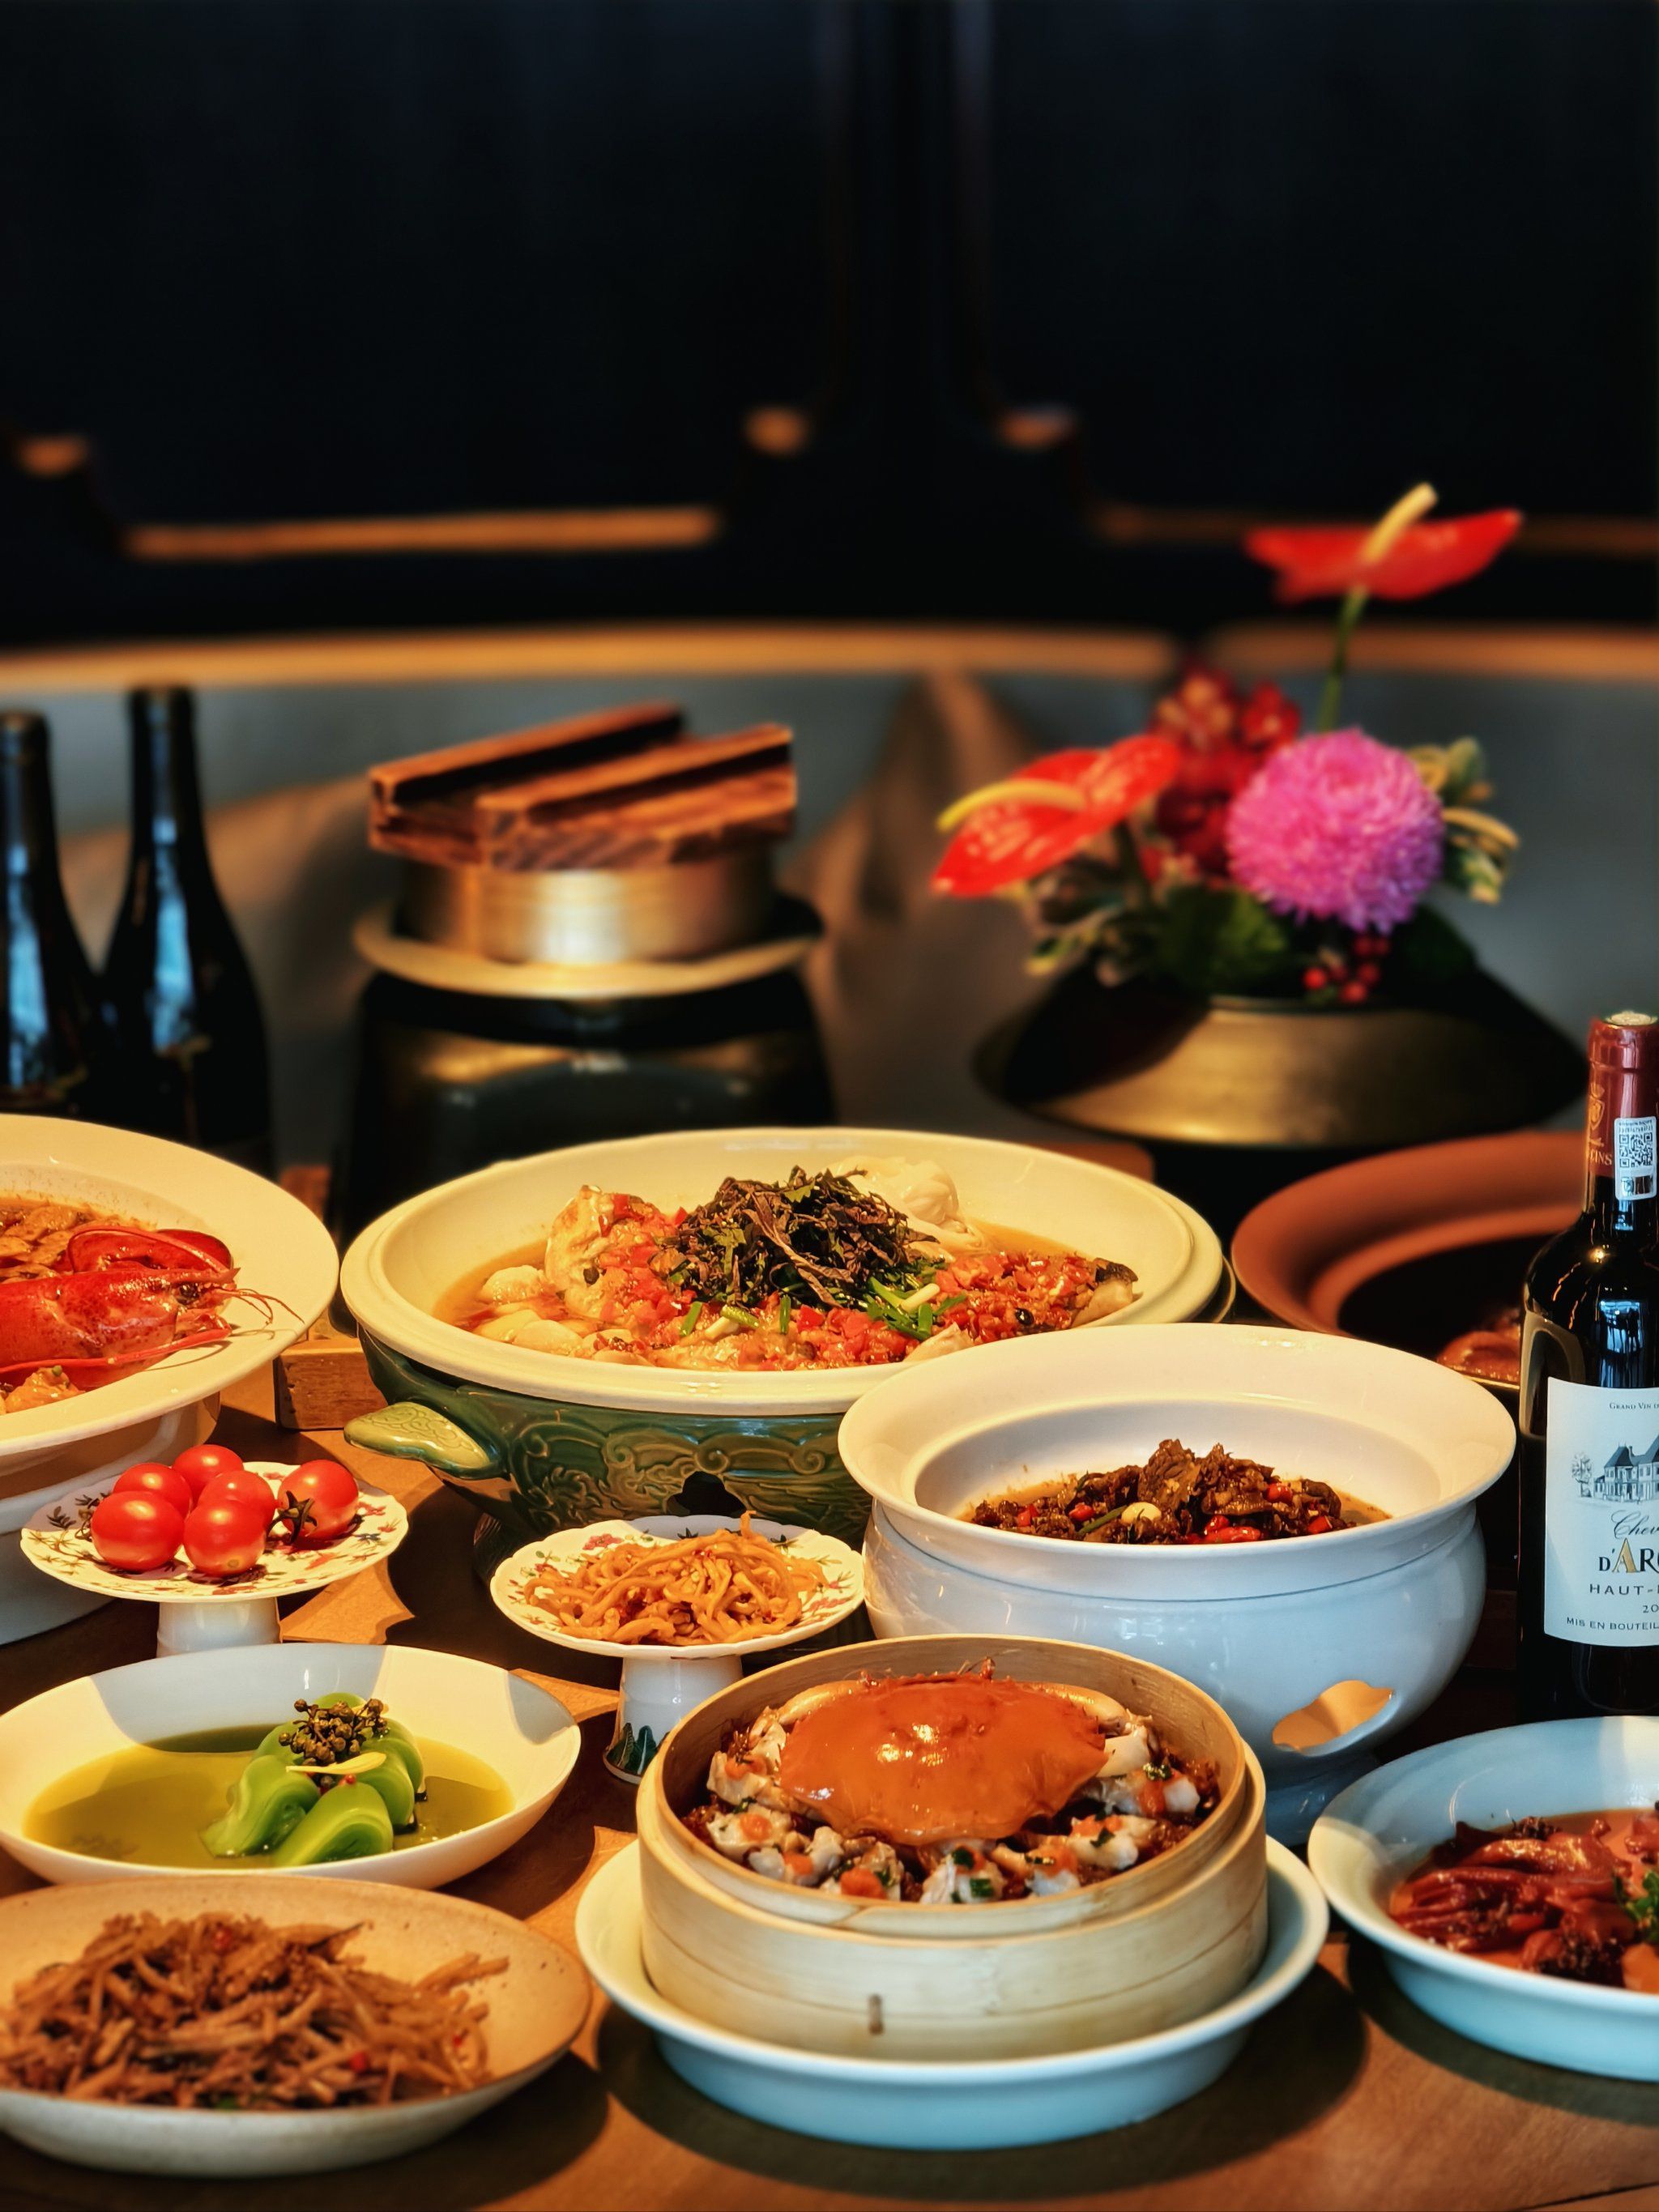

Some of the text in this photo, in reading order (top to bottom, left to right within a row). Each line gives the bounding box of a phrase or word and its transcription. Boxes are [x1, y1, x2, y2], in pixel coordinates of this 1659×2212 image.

[1589, 1583, 1659, 1596] HAUT-
[1567, 1617, 1585, 1626] MIS
[1589, 1621, 1606, 1630] EN
